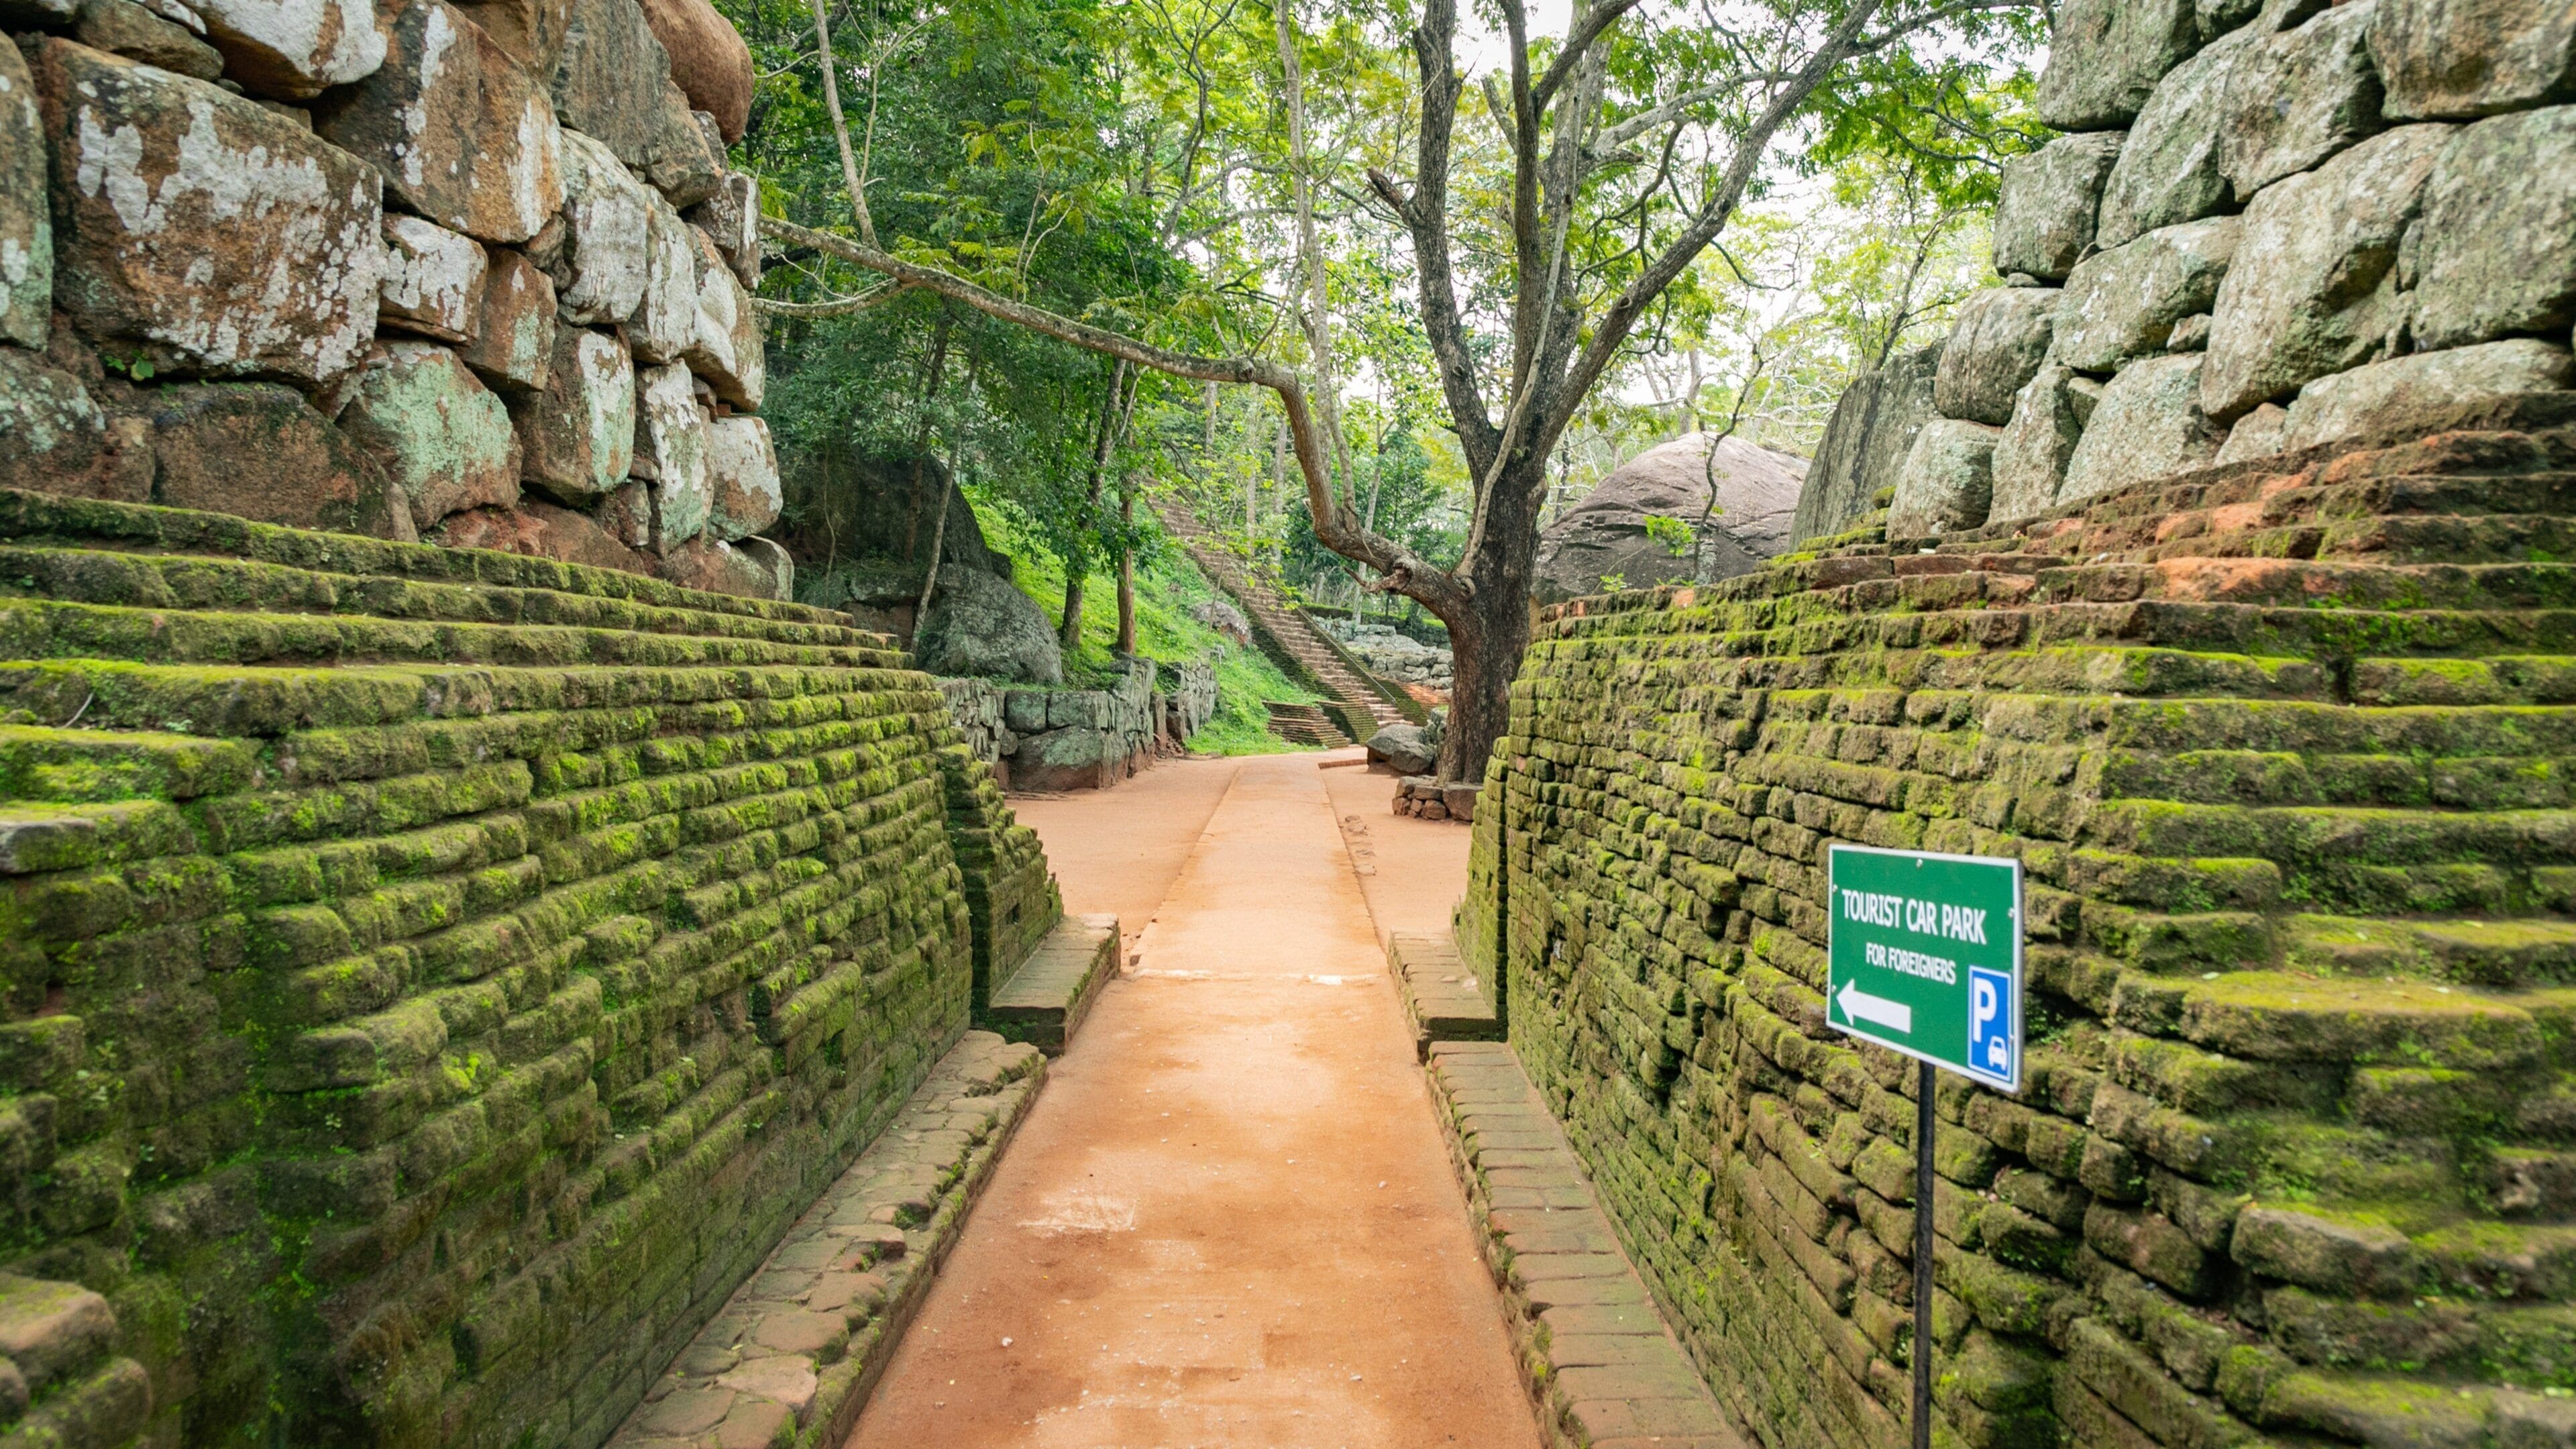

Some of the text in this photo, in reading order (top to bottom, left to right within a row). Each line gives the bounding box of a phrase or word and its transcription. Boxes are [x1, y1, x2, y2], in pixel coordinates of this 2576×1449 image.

[1841, 889, 1987, 945] TOURIST CAR PARK
[1866, 942, 1956, 985] FOR FOREIGNERS
[1973, 977, 1997, 1043] P
